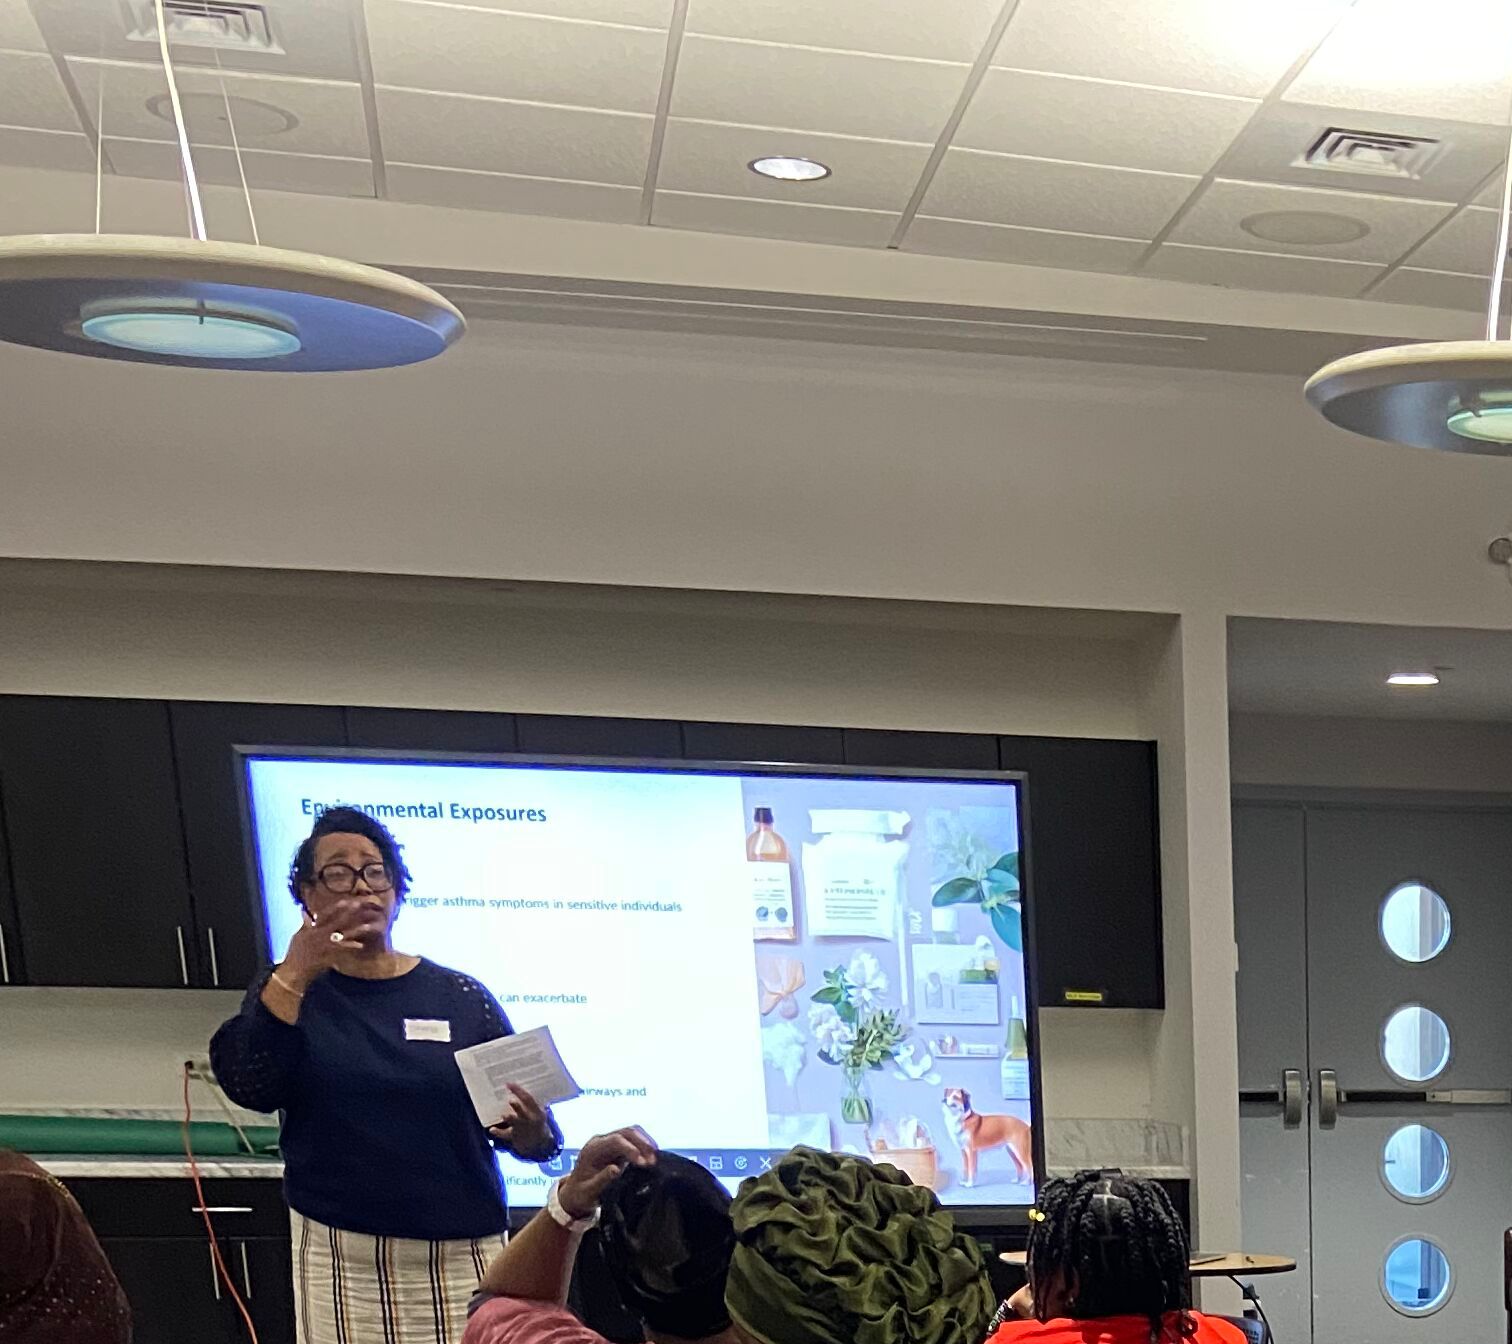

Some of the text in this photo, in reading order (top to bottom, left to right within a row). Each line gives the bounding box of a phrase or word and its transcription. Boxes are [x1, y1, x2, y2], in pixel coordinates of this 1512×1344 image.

[301, 799, 547, 823] Ennmental Exposures
[403, 896, 683, 912] rigger asthma symptoms in sensitive individuals
[523, 993, 588, 1004] exacerbate
[626, 1086, 647, 1096] and
[506, 1175, 547, 1187] ificantly
